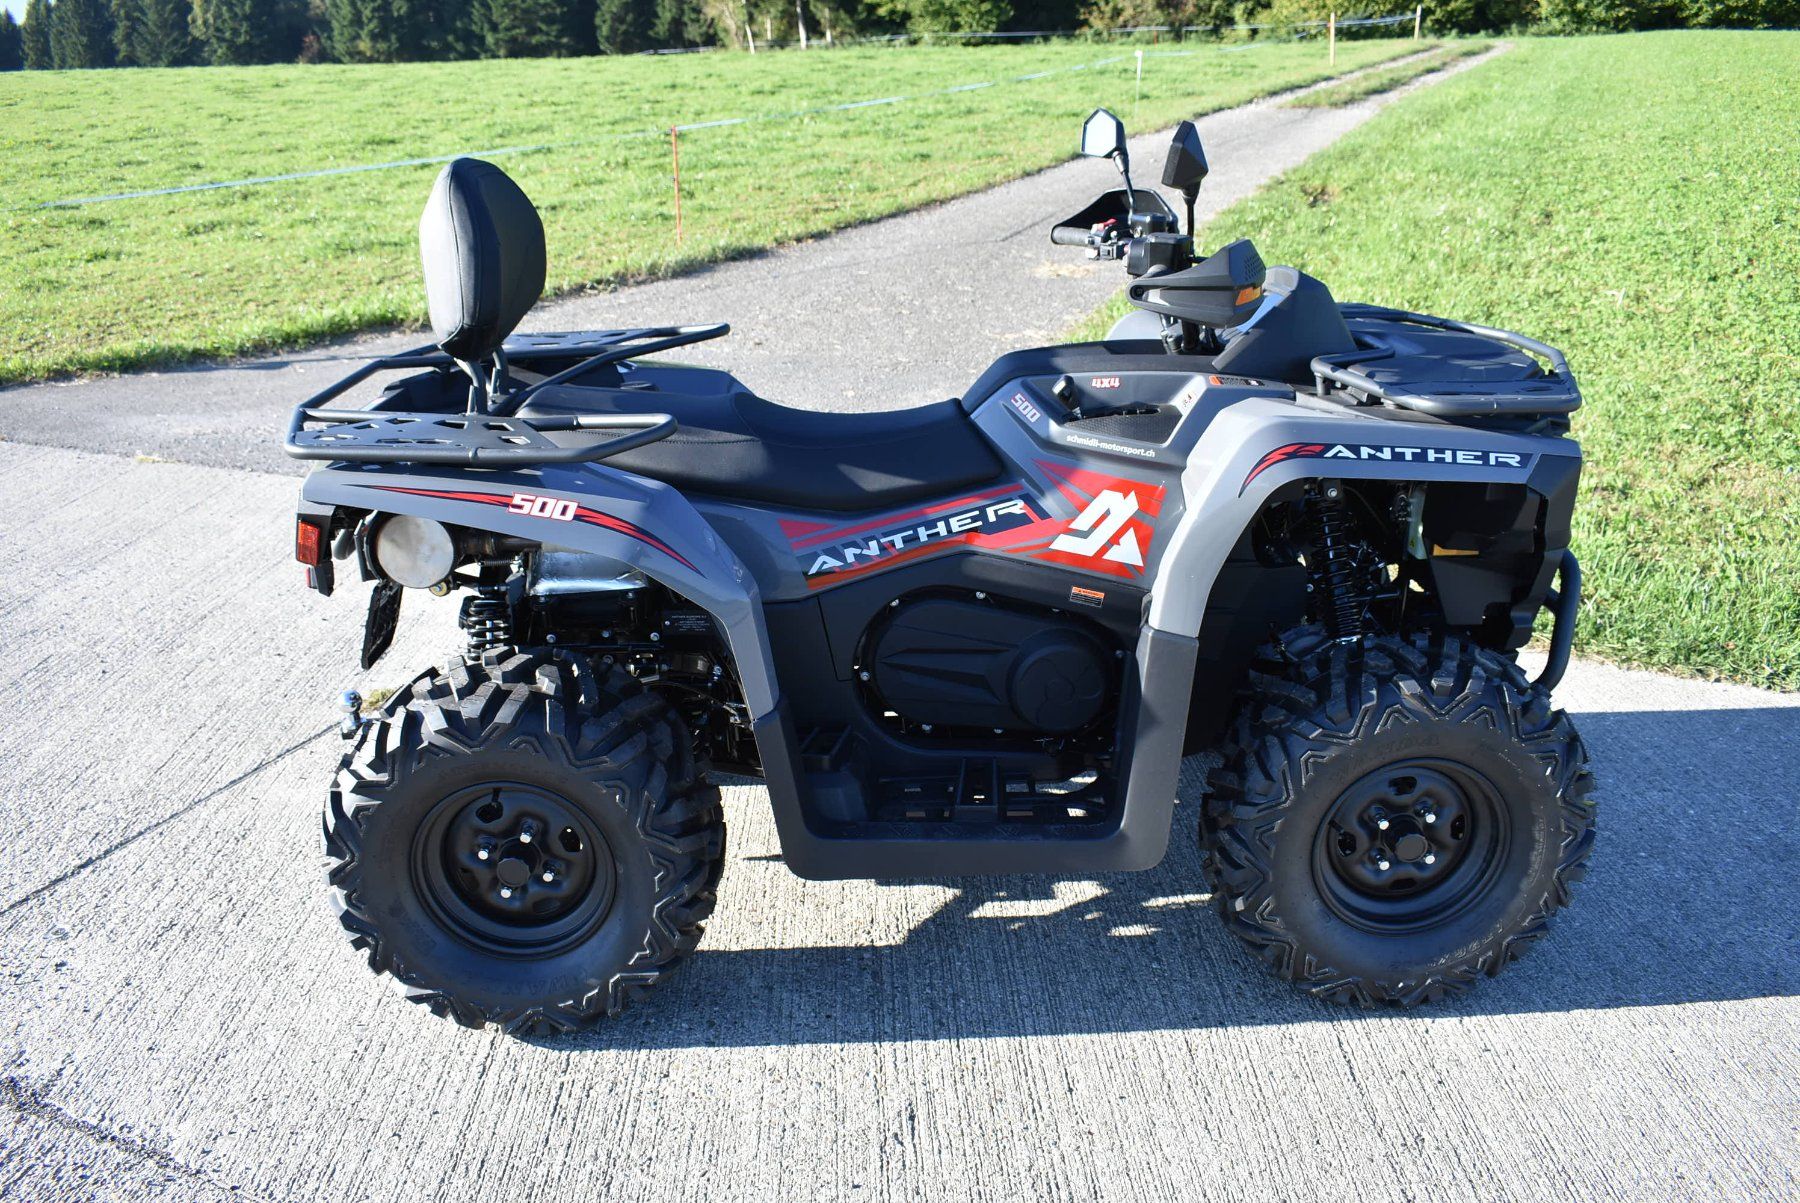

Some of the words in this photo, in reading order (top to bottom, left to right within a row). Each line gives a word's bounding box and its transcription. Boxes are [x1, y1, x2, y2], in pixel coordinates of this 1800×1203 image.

[1011, 393, 1041, 423] 500
[1323, 444, 1521, 467] ANTHER
[508, 493, 578, 521] 500
[808, 498, 1025, 575] ANTHER
